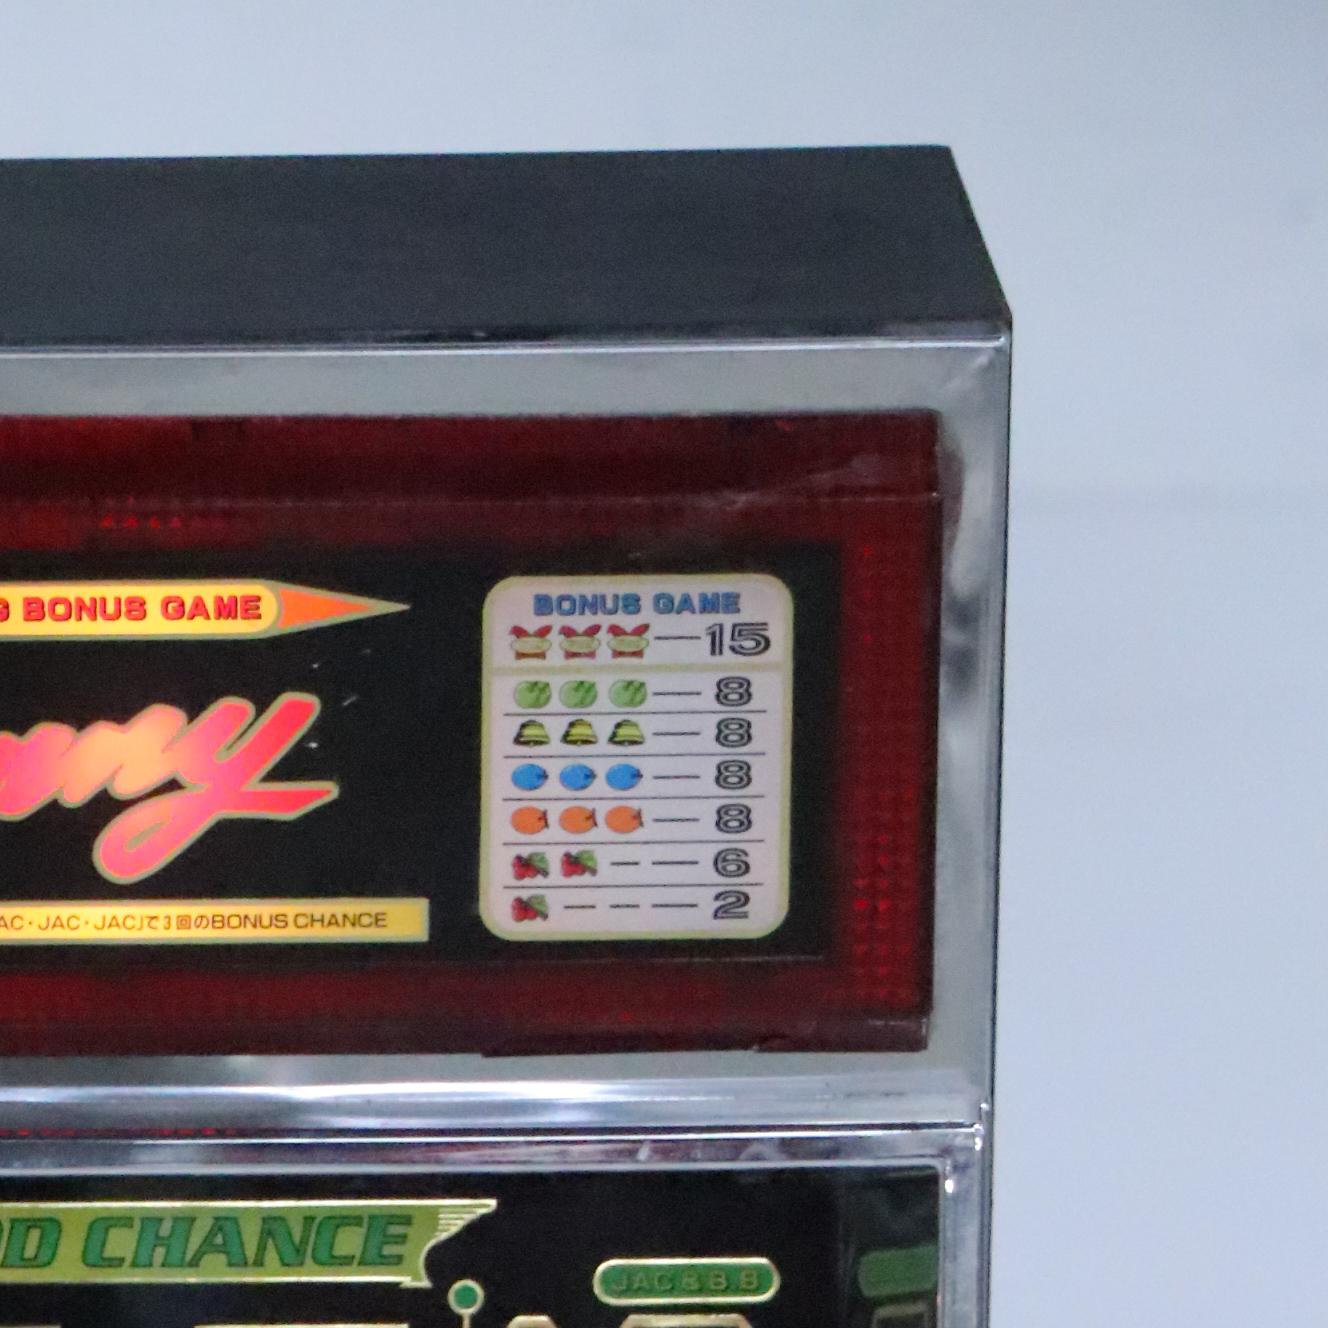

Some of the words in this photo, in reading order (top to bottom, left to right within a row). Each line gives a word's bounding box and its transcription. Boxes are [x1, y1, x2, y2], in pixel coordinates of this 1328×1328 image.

[22, 596, 147, 622] BONUS
[160, 595, 262, 621] GAME
[533, 592, 642, 616] BONUS
[653, 591, 741, 616] GAME
[705, 622, 771, 657] 15
[714, 676, 753, 707] 8
[715, 717, 753, 748] 8
[714, 760, 753, 790] 8
[715, 803, 753, 834] 8
[712, 848, 751, 878] 6
[712, 890, 751, 920] 2
[294, 911, 389, 930] CHANCE
[81, 1214, 414, 1269] CHANCE
